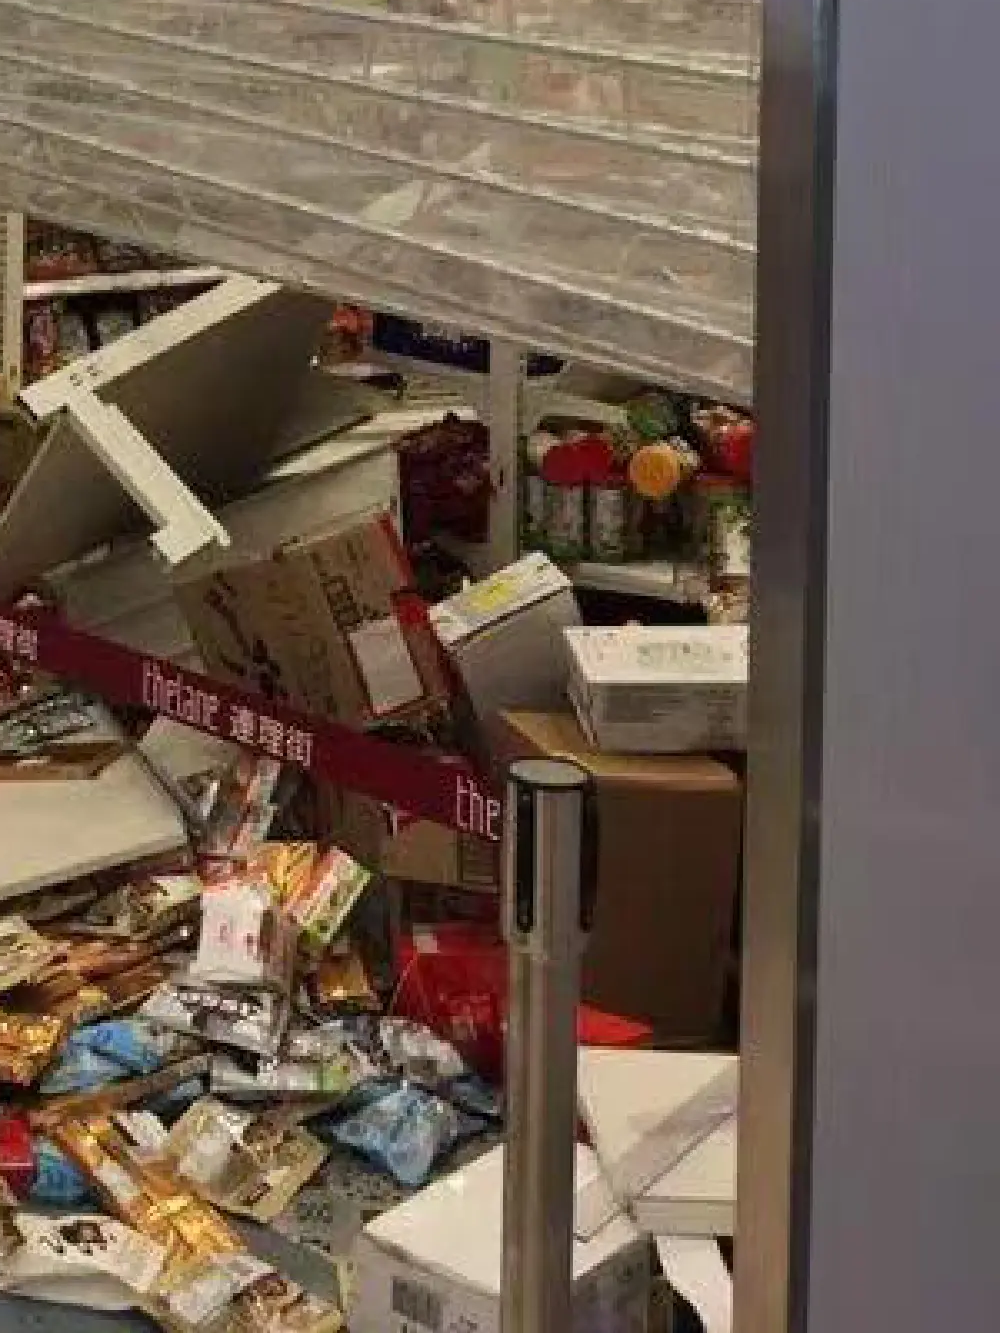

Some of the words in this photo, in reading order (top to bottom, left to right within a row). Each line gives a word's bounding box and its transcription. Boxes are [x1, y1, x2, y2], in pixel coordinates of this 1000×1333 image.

[229, 705, 315, 768] 連理街
[455, 775, 501, 842] the
